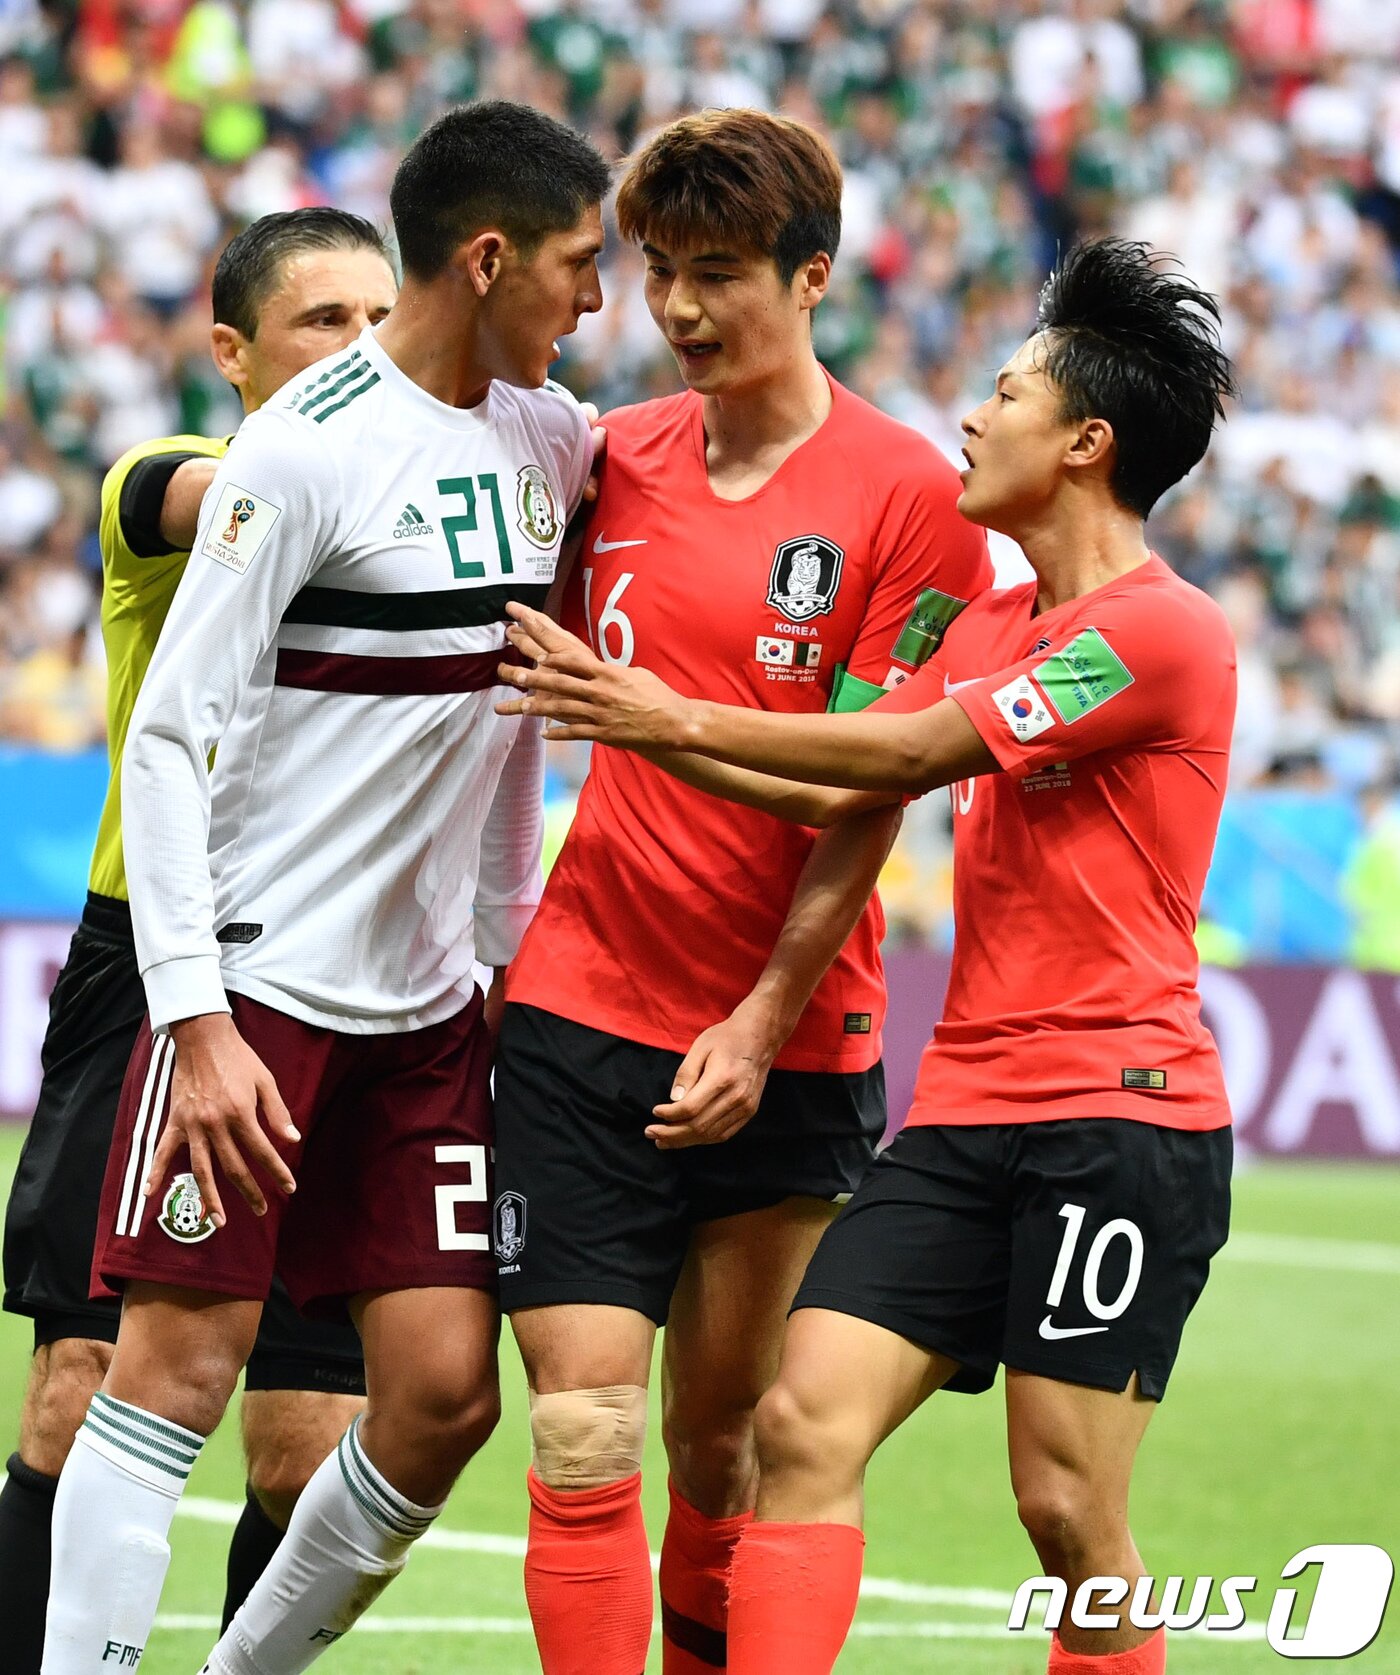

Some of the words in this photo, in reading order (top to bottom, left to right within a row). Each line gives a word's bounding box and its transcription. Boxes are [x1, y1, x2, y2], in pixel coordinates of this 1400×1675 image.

[393, 524, 434, 539] adidas
[437, 473, 513, 579] 21
[583, 567, 634, 667] 16
[774, 622, 819, 637] KOREA
[766, 672, 776, 681] 23
[777, 674, 797, 682] JUNE
[798, 675, 816, 683] 2018
[1072, 686, 1089, 709] FIFA
[1053, 780, 1072, 788] 2018
[498, 1264, 521, 1276] KOREA
[1046, 1203, 1144, 1320] 10
[102, 1640, 144, 1667] FMF
